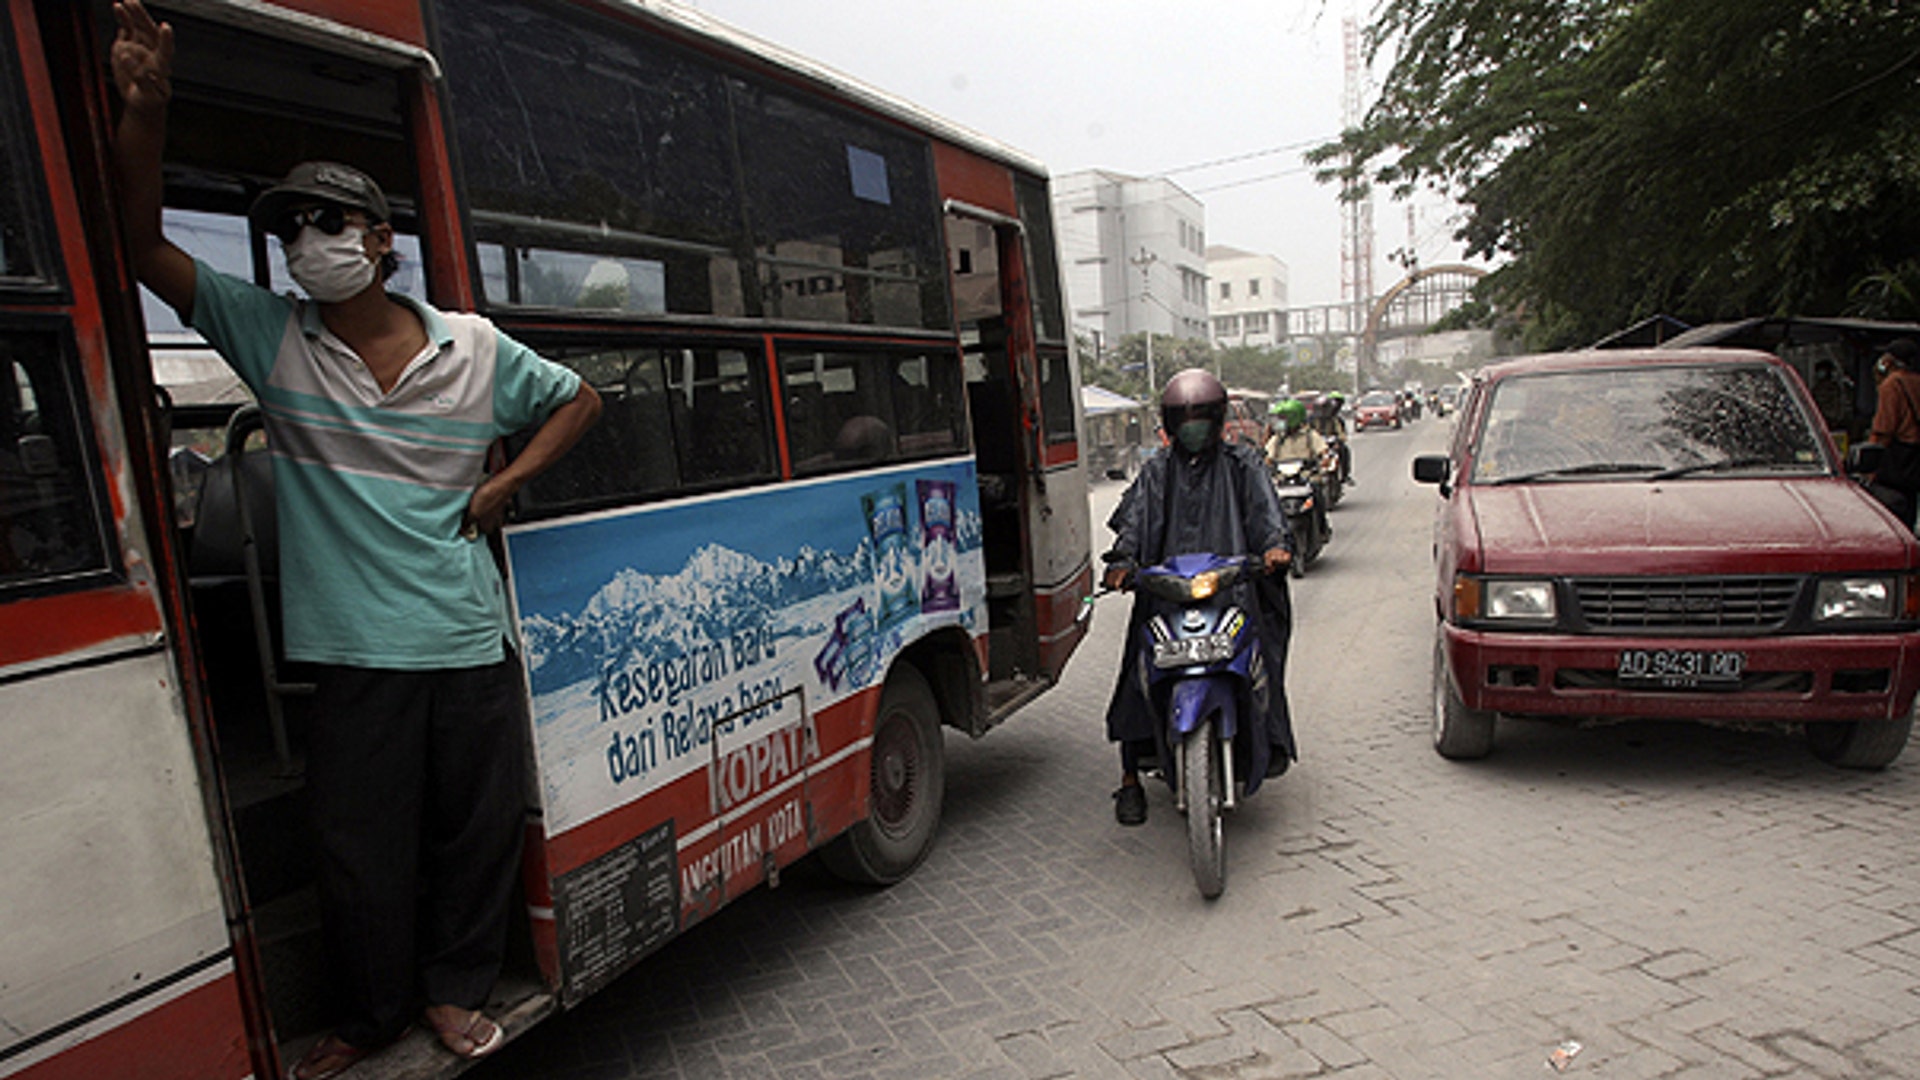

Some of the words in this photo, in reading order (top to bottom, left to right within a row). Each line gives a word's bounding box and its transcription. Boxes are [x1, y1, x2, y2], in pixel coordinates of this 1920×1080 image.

[600, 642, 729, 722] Kesegaran
[1620, 651, 1648, 673] AD
[607, 717, 656, 784] dari
[707, 713, 822, 815] KOPATA
[768, 798, 803, 850] KOTA
